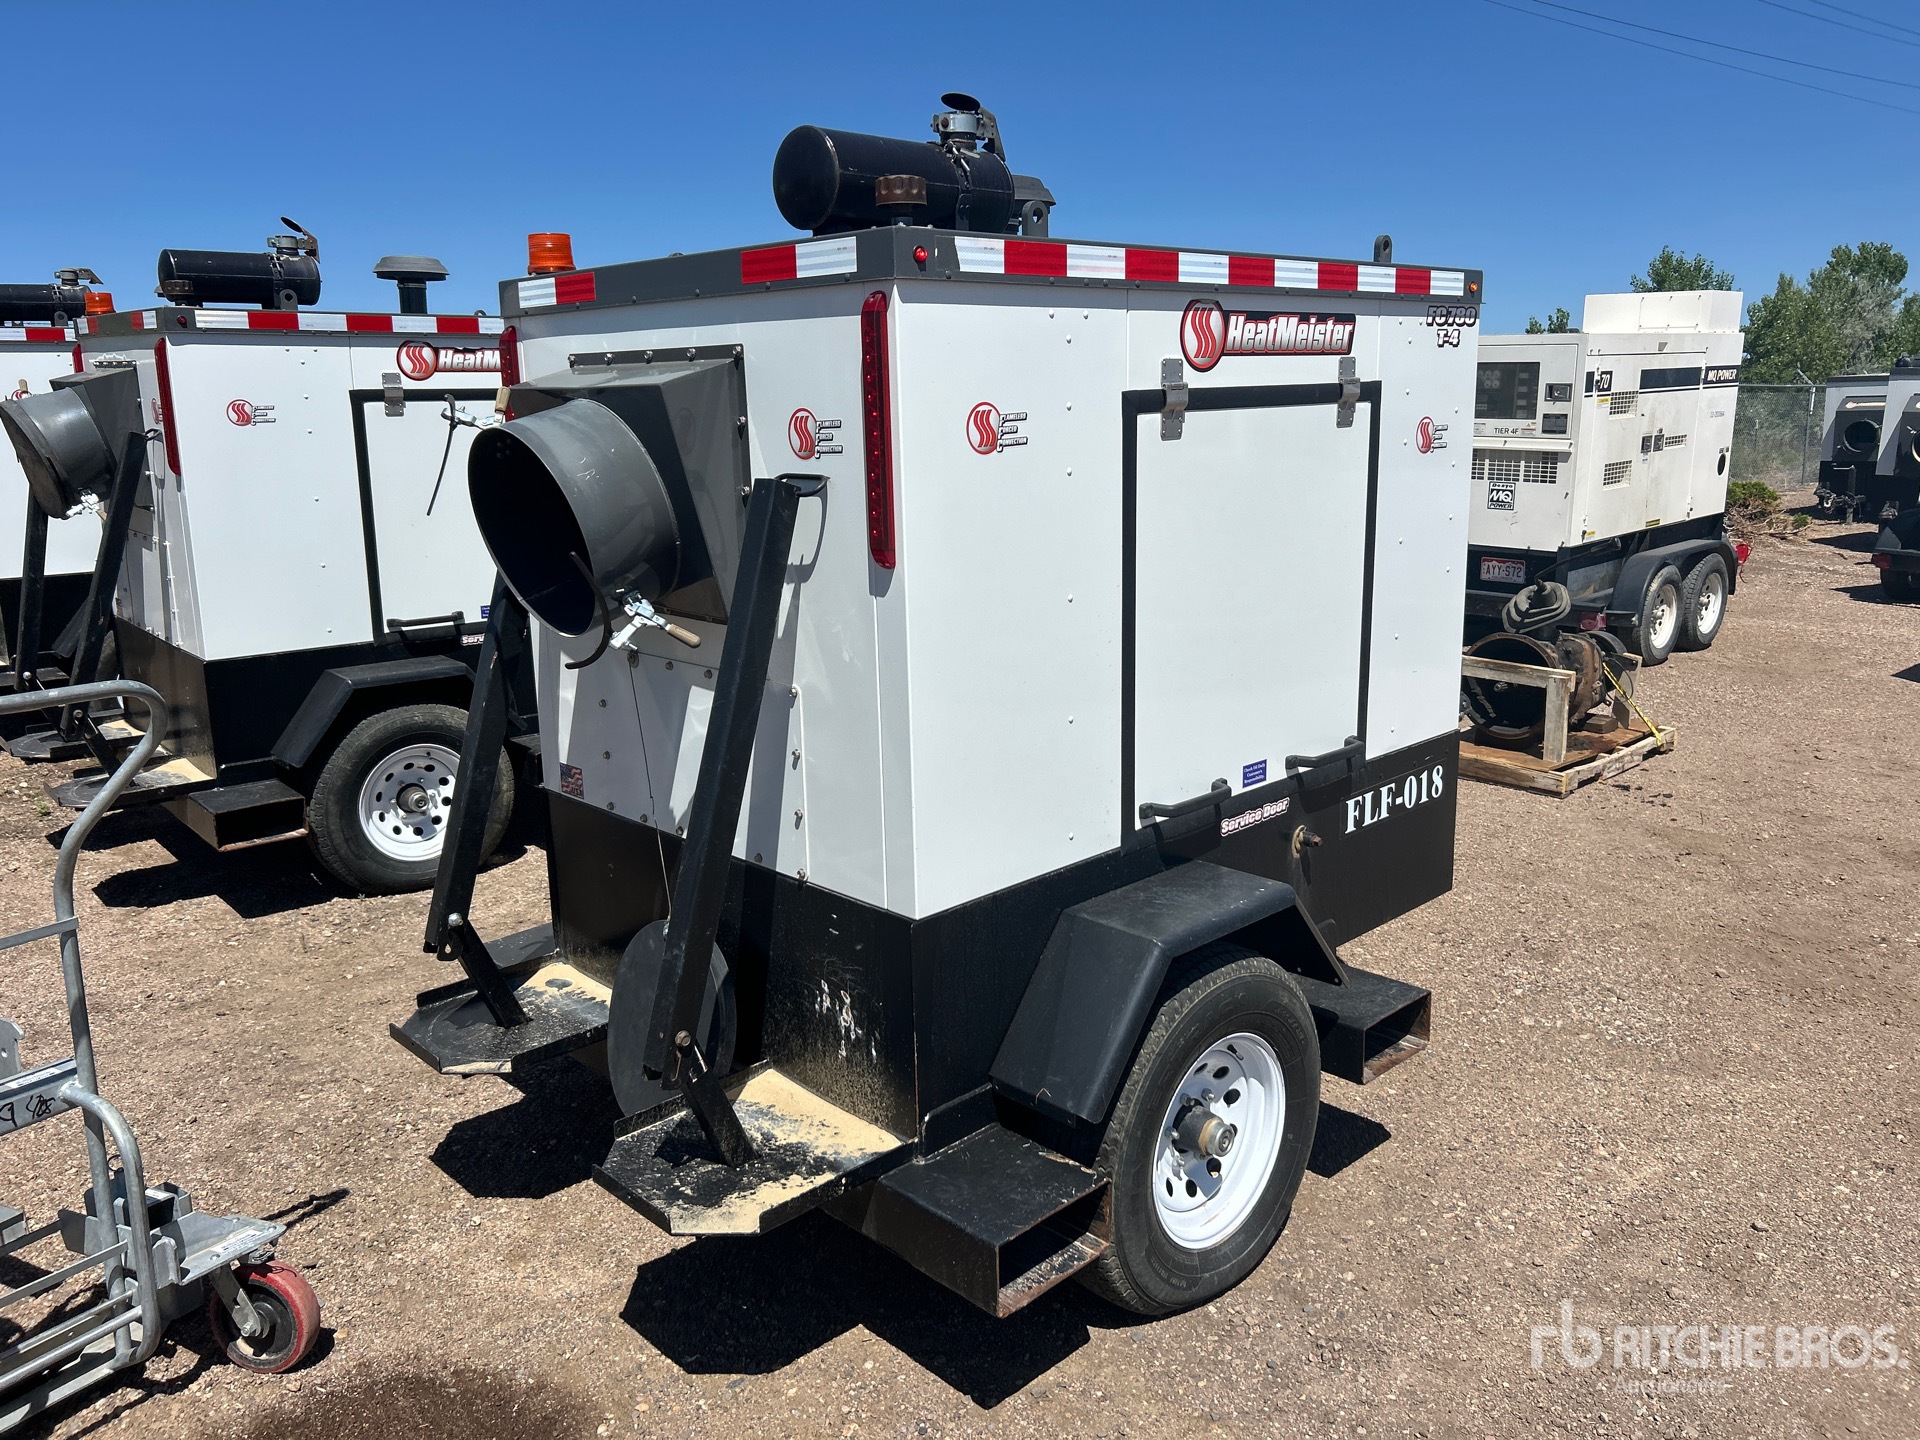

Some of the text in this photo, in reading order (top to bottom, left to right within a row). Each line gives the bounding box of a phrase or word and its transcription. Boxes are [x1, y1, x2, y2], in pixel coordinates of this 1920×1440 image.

[1224, 312, 1355, 353] HeatMeister
[1437, 328, 1461, 347] T-4
[1707, 369, 1737, 382] MQ POWER
[816, 419, 842, 434] FLAMELESS
[999, 411, 1028, 427] FLAMELESS
[998, 425, 1019, 440] FORCED
[1494, 427, 1510, 435] TIER
[815, 432, 834, 446] FORCED
[996, 437, 1028, 453] CONVECTION
[814, 444, 844, 459] CONVECTION
[1489, 489, 1514, 503] MQ
[1345, 765, 1444, 834] FLF-018
[1221, 797, 1290, 836] Service Door
